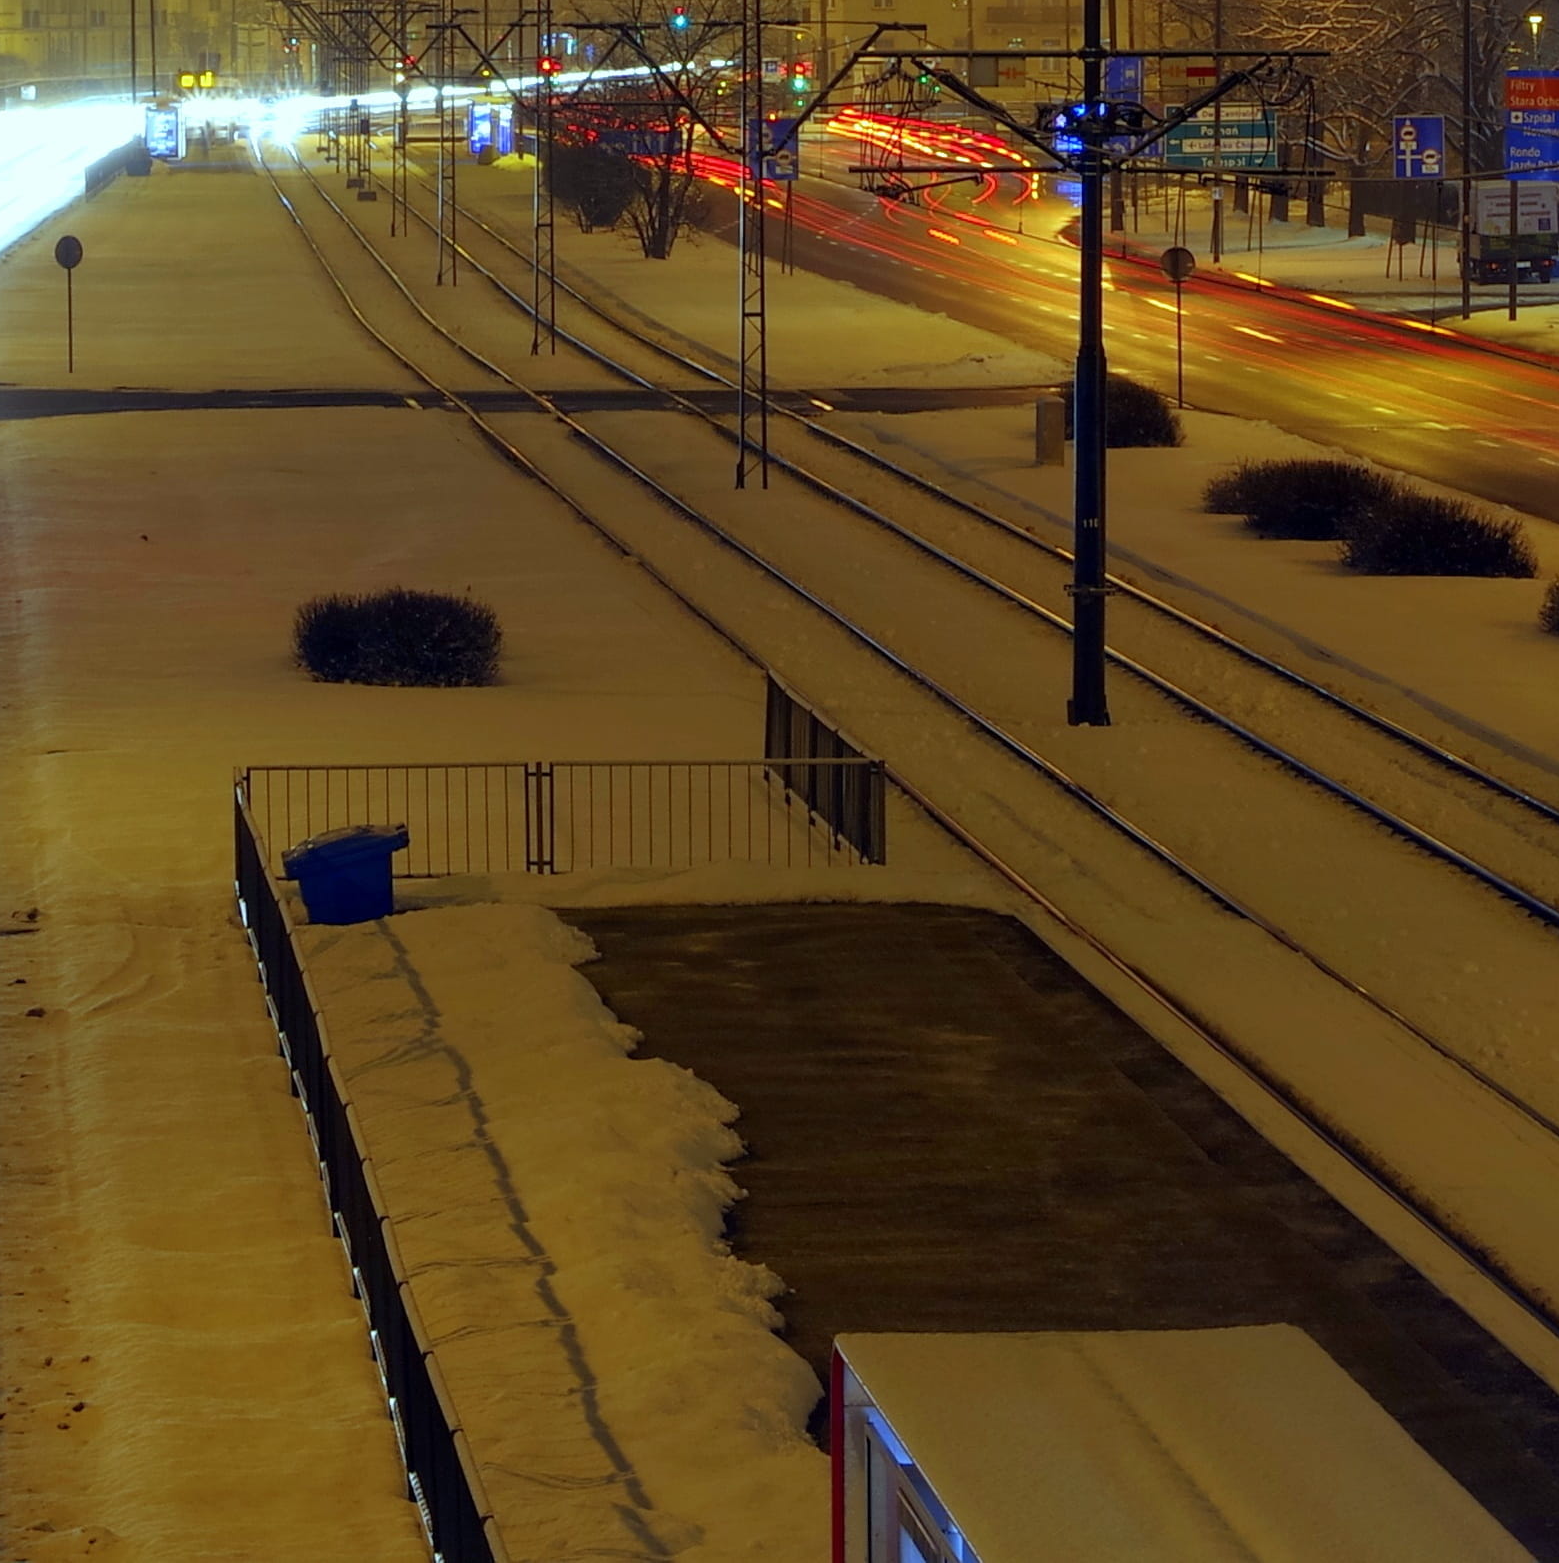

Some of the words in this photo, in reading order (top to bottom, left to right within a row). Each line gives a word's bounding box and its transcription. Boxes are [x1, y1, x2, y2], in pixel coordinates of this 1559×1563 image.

[1510, 96, 1535, 107] Stara
[1523, 112, 1556, 125] Szpital
[1200, 125, 1239, 136] Ponań
[1510, 146, 1541, 157] Rondo
